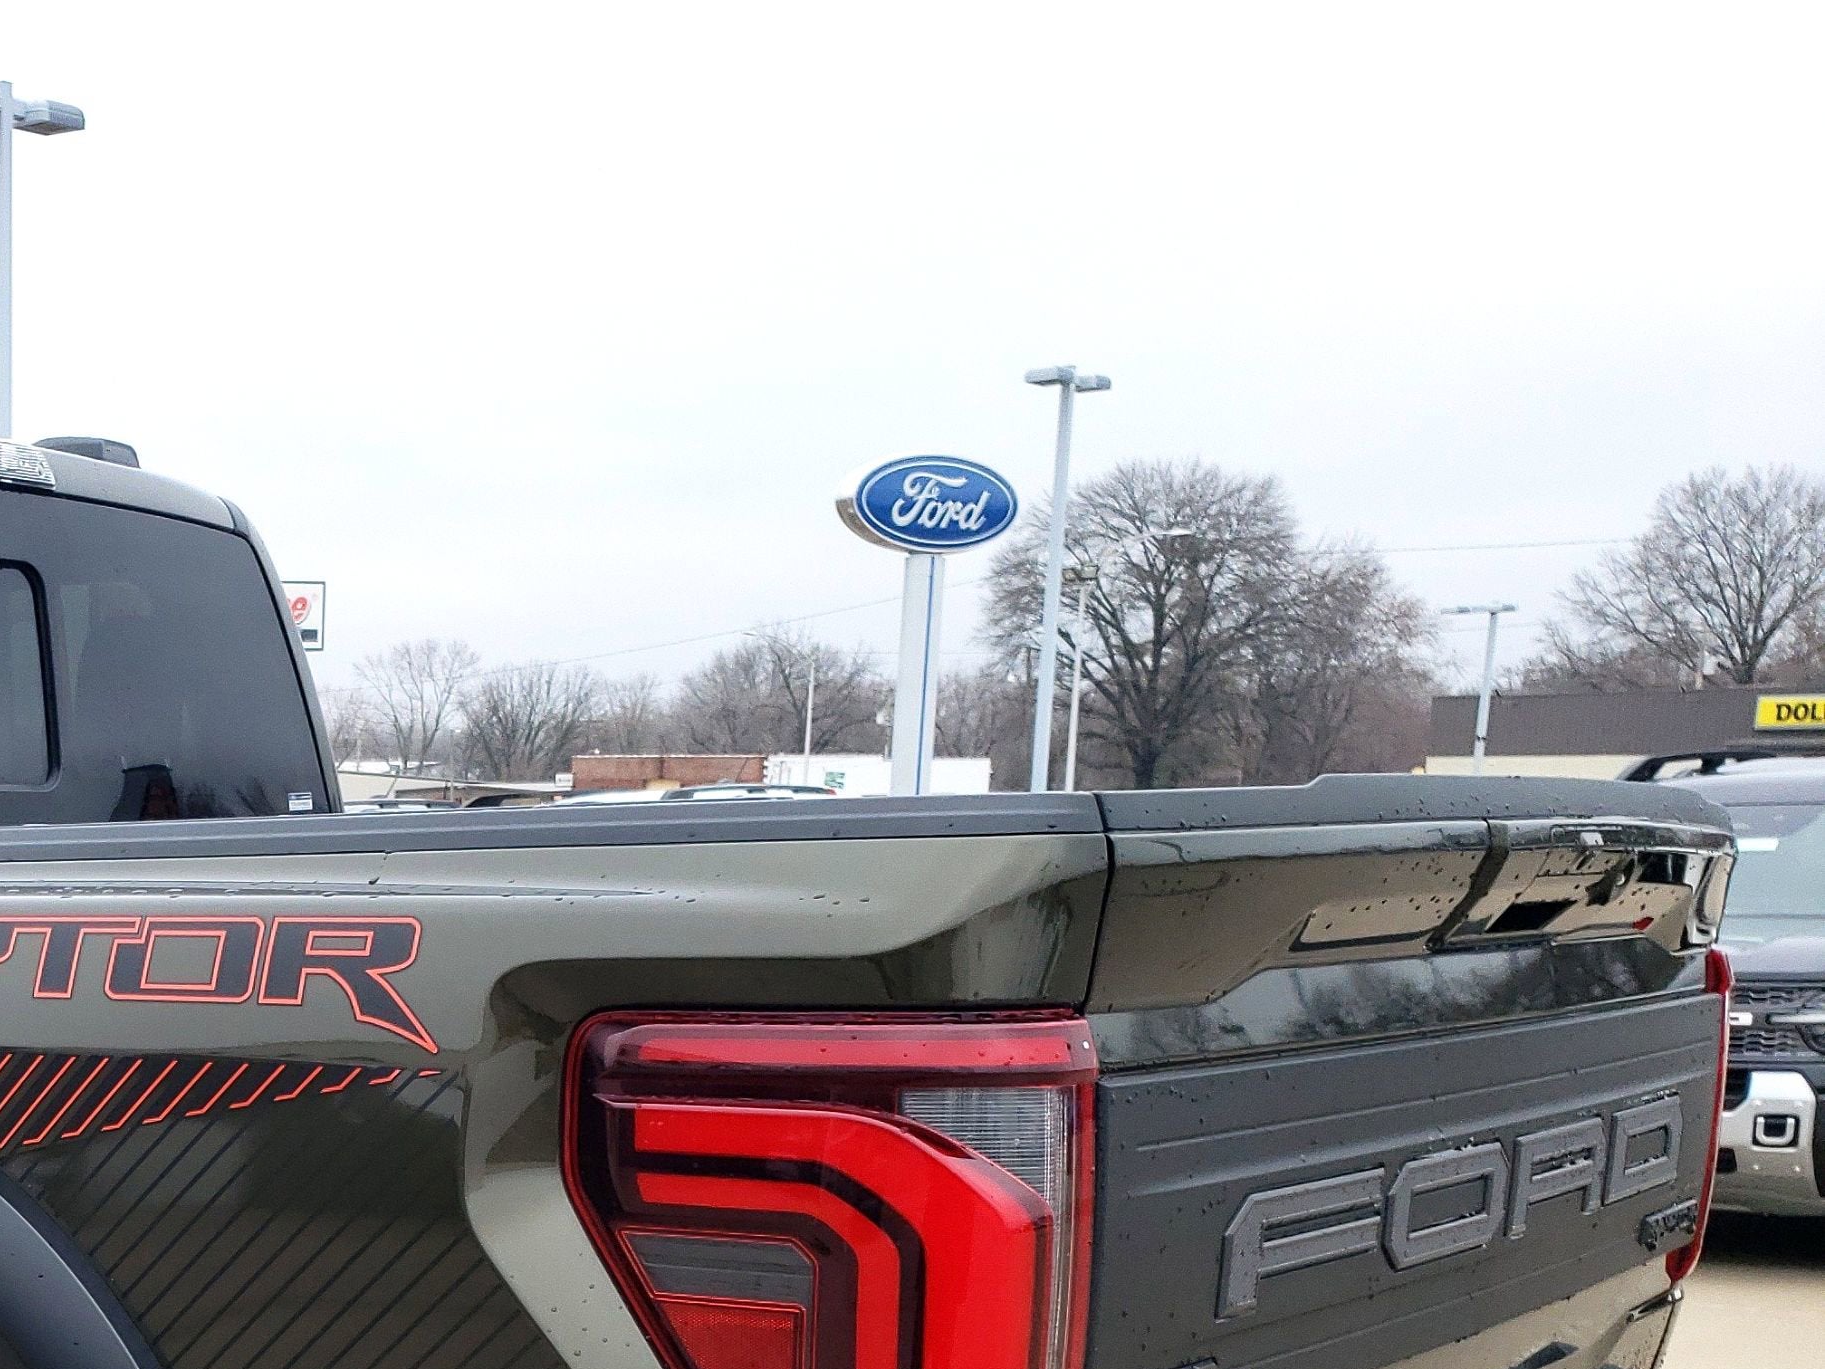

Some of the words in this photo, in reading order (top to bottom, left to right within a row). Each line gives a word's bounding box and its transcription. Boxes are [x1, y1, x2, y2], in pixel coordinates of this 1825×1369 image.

[891, 471, 991, 530] Ford
[1776, 703, 1825, 721] DOL
[1215, 1092, 1682, 1322] FORD
